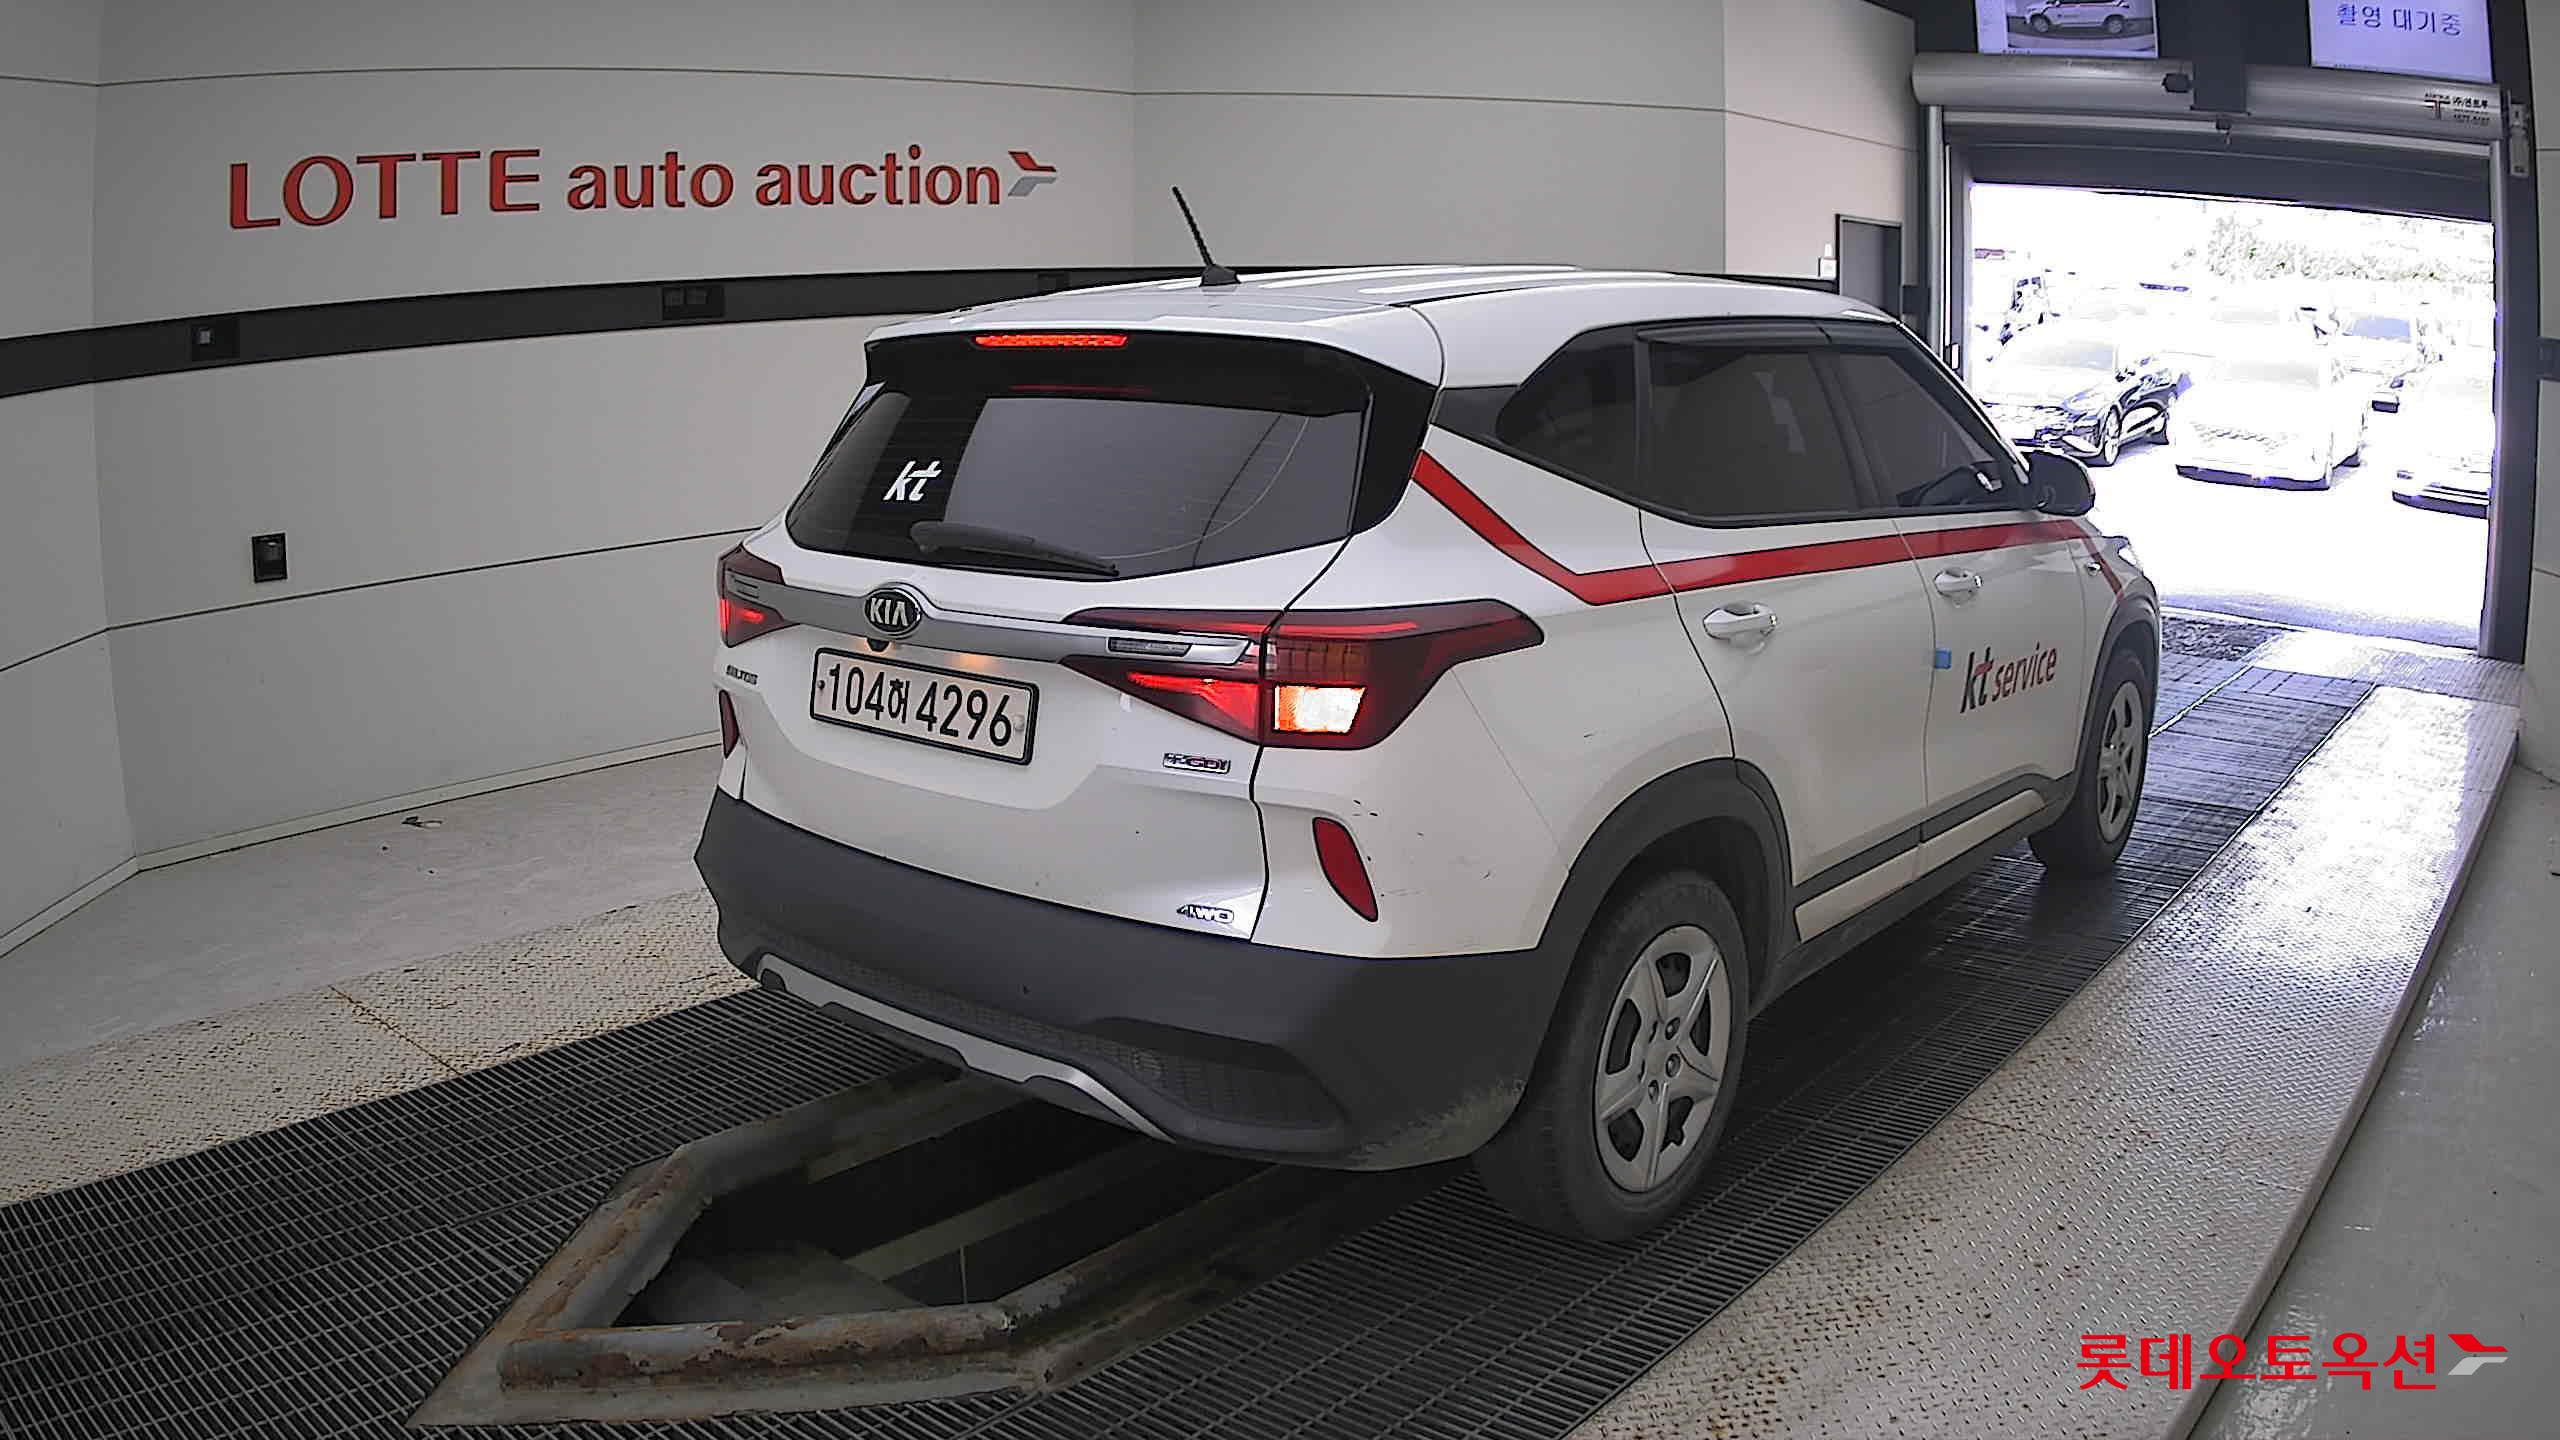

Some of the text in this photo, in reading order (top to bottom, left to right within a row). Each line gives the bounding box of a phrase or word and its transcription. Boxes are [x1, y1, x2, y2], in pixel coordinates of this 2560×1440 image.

[2337, 3, 2462, 37] 촬영 대기중
[228, 144, 1001, 231] LOTTE auto auction
[882, 460, 943, 502] kt
[869, 595, 909, 628] KIA
[828, 662, 1013, 748] 104허 4296
[1960, 641, 2057, 714] kt service
